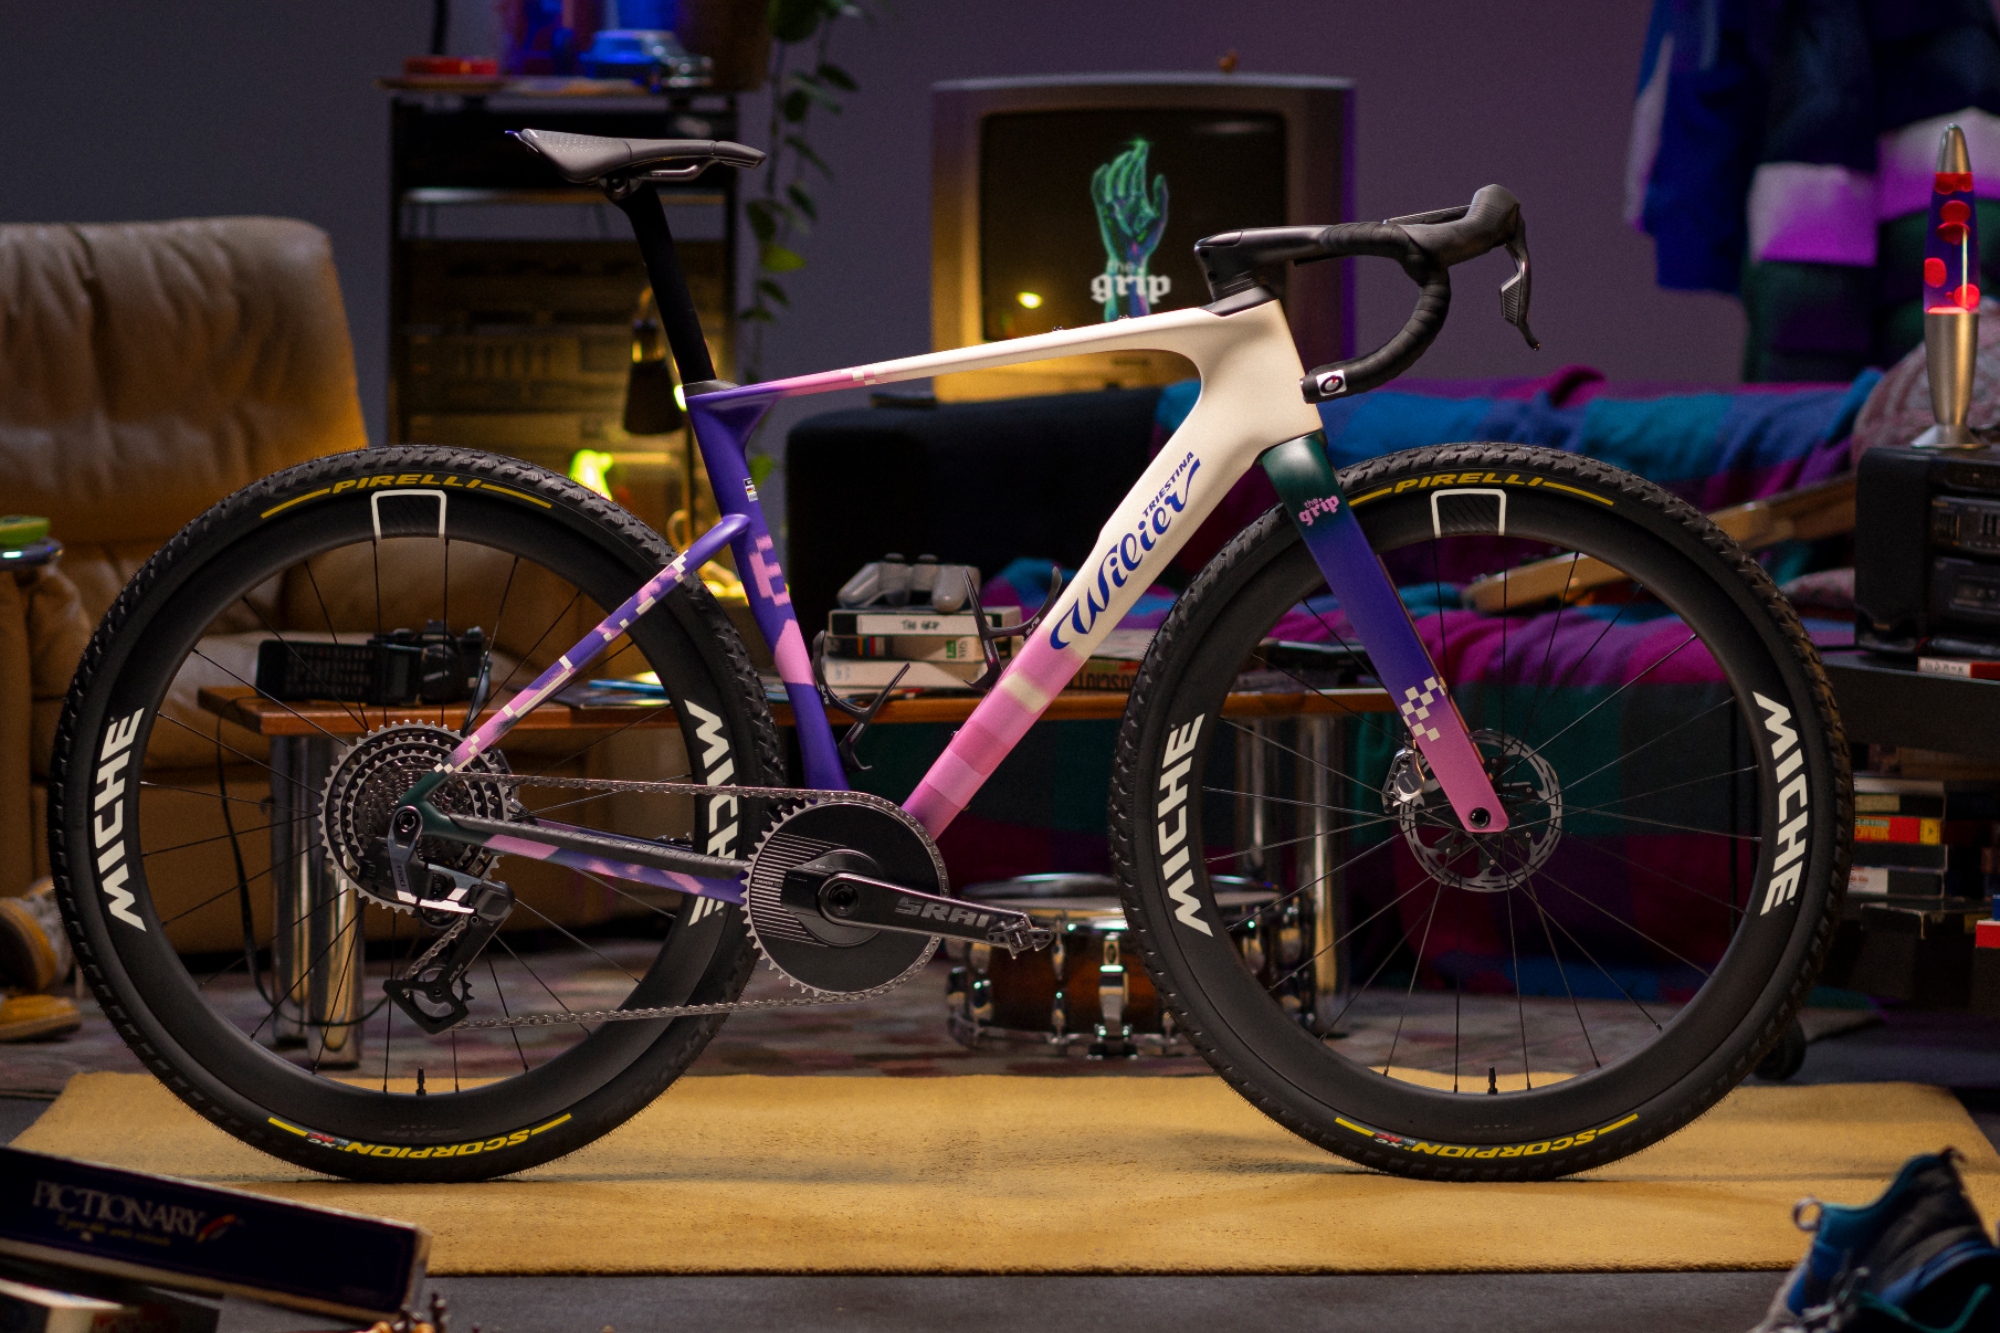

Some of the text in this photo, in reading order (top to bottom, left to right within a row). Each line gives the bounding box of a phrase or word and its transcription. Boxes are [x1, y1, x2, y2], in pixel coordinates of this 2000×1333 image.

[1091, 267, 1172, 305] grip
[332, 474, 482, 494] PIRELLI
[1142, 451, 1195, 518] TRIESTINA
[1394, 472, 1543, 493] PIRELLI
[1298, 495, 1339, 526] grip
[1050, 457, 1201, 650] Wilier
[94, 707, 147, 932] MICHE
[1157, 713, 1213, 937] MICHE
[1752, 691, 1808, 916] MICHE
[343, 1129, 532, 1159] SCORPION
[1412, 1129, 1598, 1159] SCORPION
[32, 1179, 206, 1238] PICTIONARY
